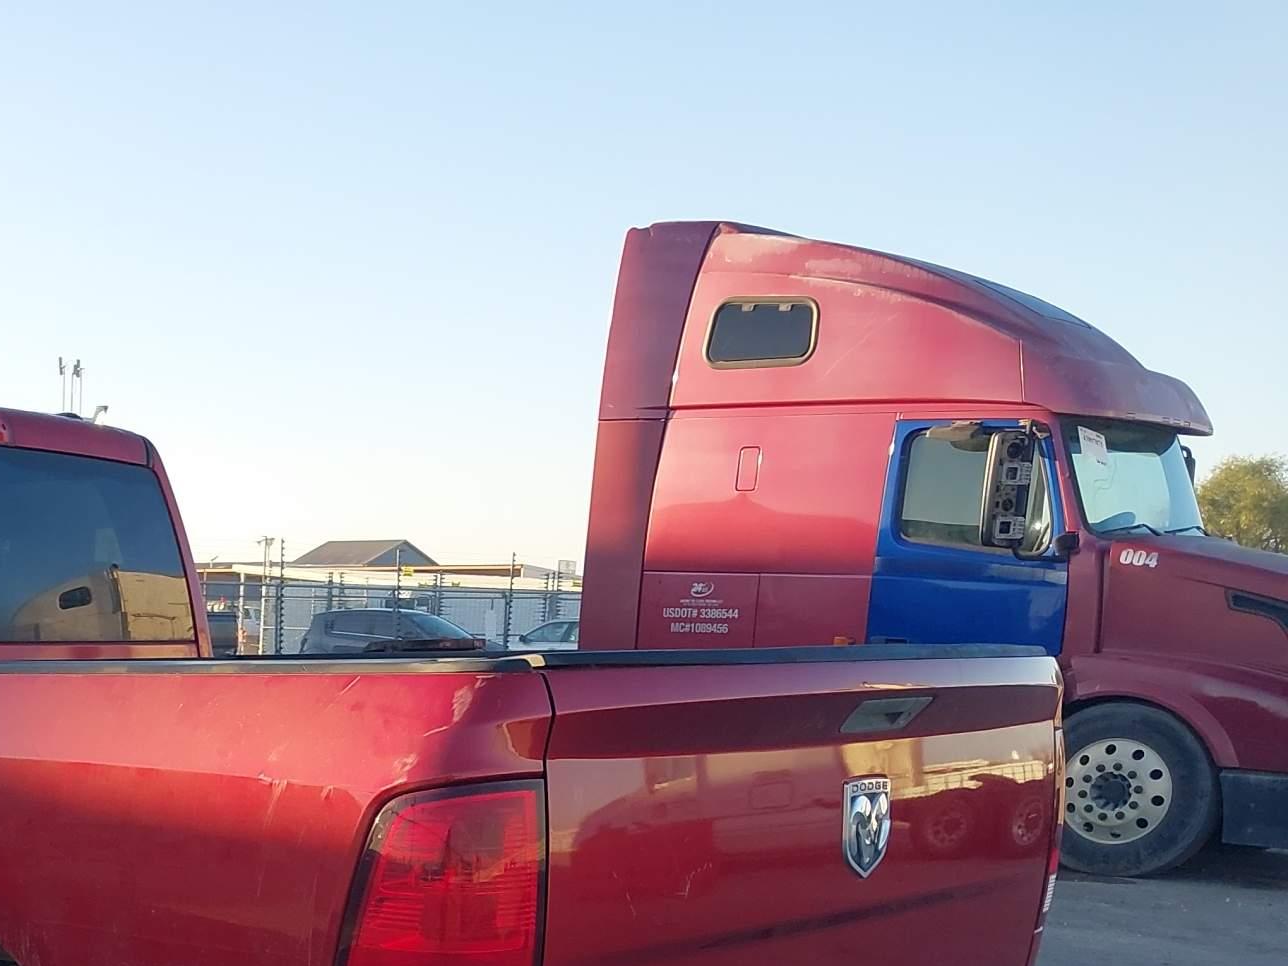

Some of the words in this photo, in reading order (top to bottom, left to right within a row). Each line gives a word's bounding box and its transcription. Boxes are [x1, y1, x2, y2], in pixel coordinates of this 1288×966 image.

[1119, 548, 1159, 568] 004
[663, 607, 698, 618] USDOT#
[699, 608, 739, 619] 3386544
[851, 781, 889, 793] DODGE
